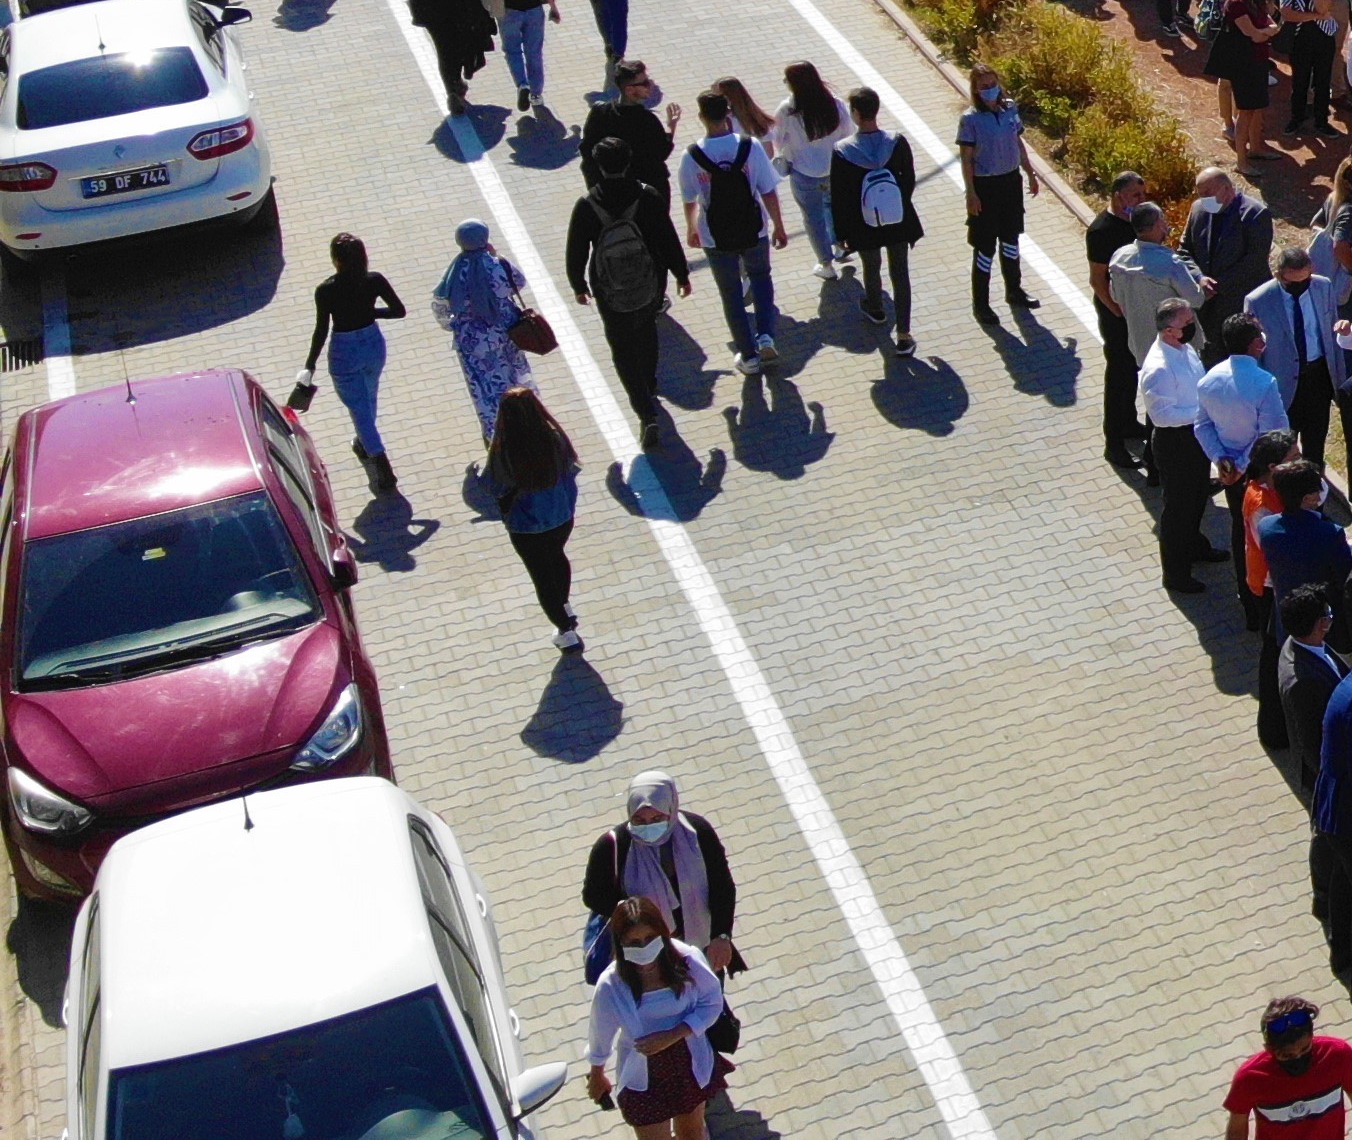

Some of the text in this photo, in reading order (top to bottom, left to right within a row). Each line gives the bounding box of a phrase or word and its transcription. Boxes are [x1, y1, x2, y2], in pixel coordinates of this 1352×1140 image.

[90, 170, 166, 193] 59 DF 744
